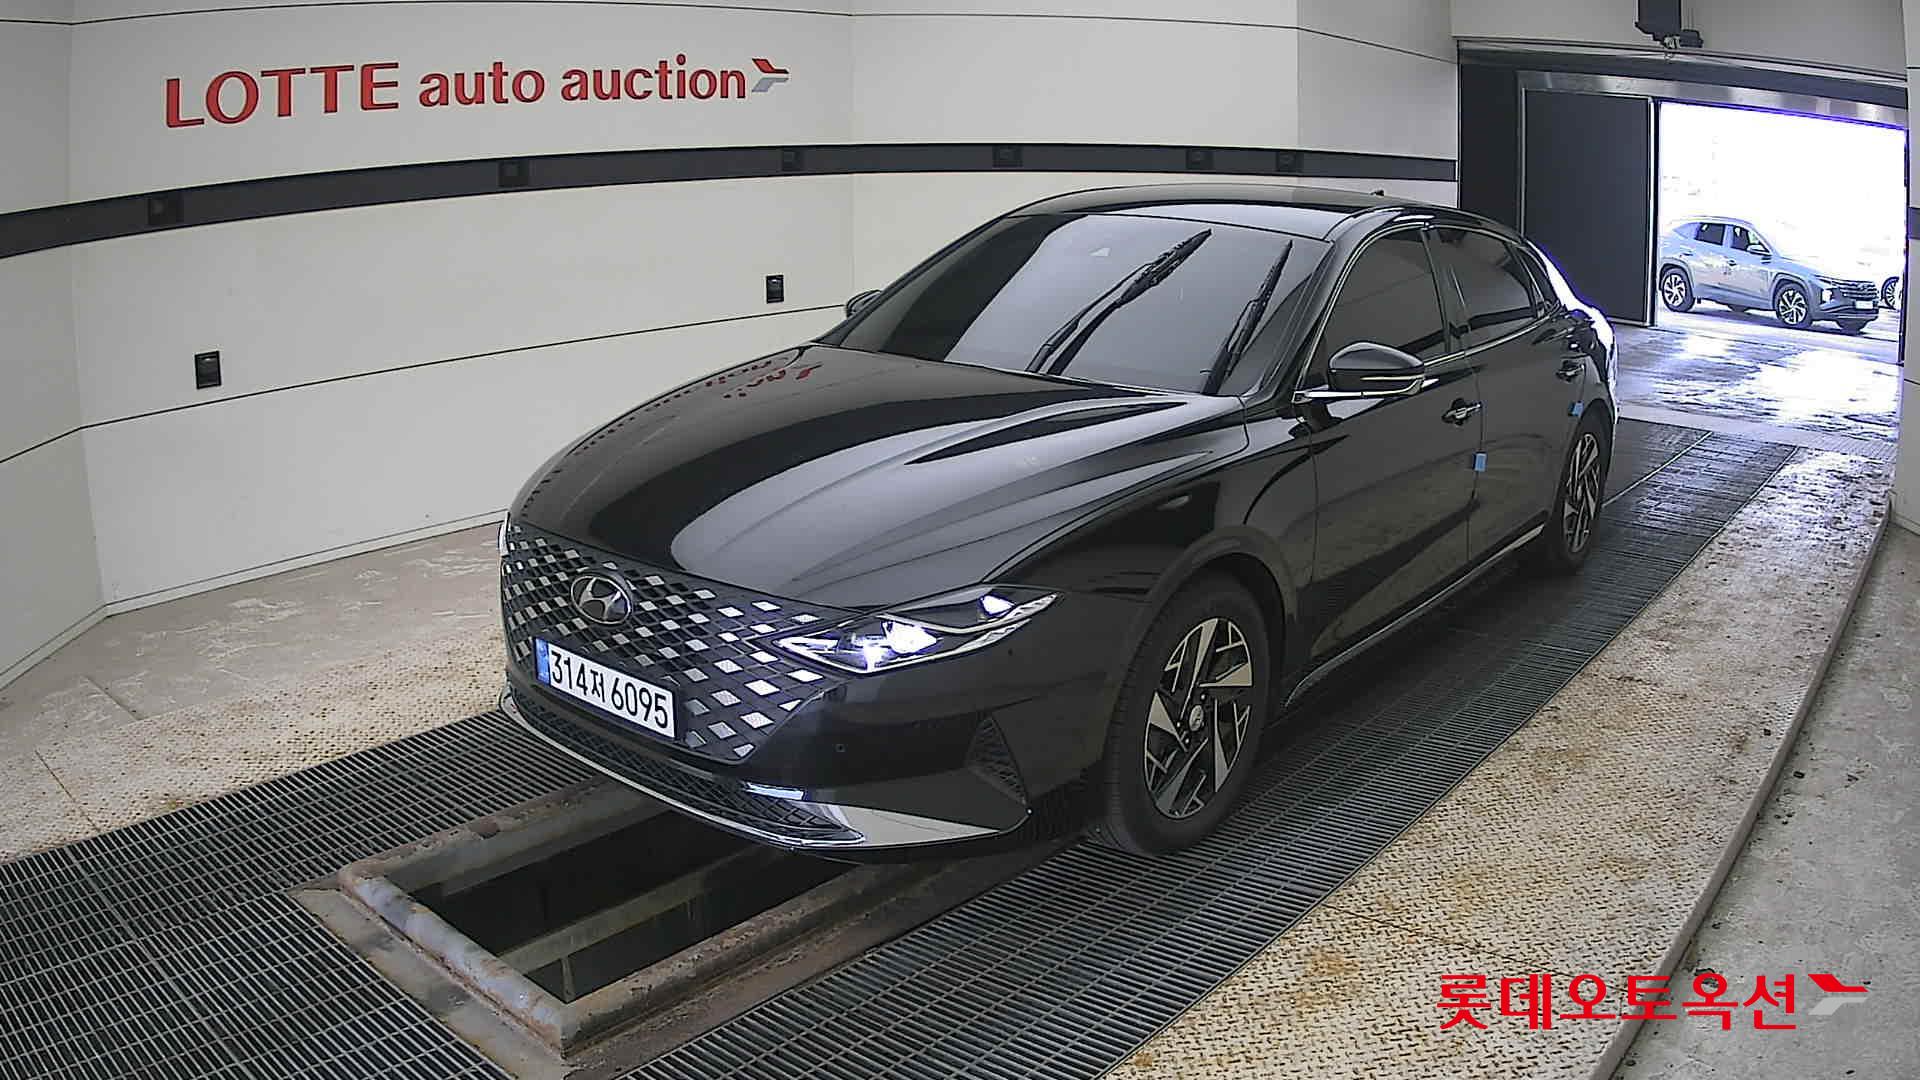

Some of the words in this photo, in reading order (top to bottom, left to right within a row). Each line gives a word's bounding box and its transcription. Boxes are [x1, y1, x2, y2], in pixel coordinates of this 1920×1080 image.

[167, 63, 398, 127] LOTTE
[420, 61, 545, 107] auto
[562, 53, 746, 100] auction
